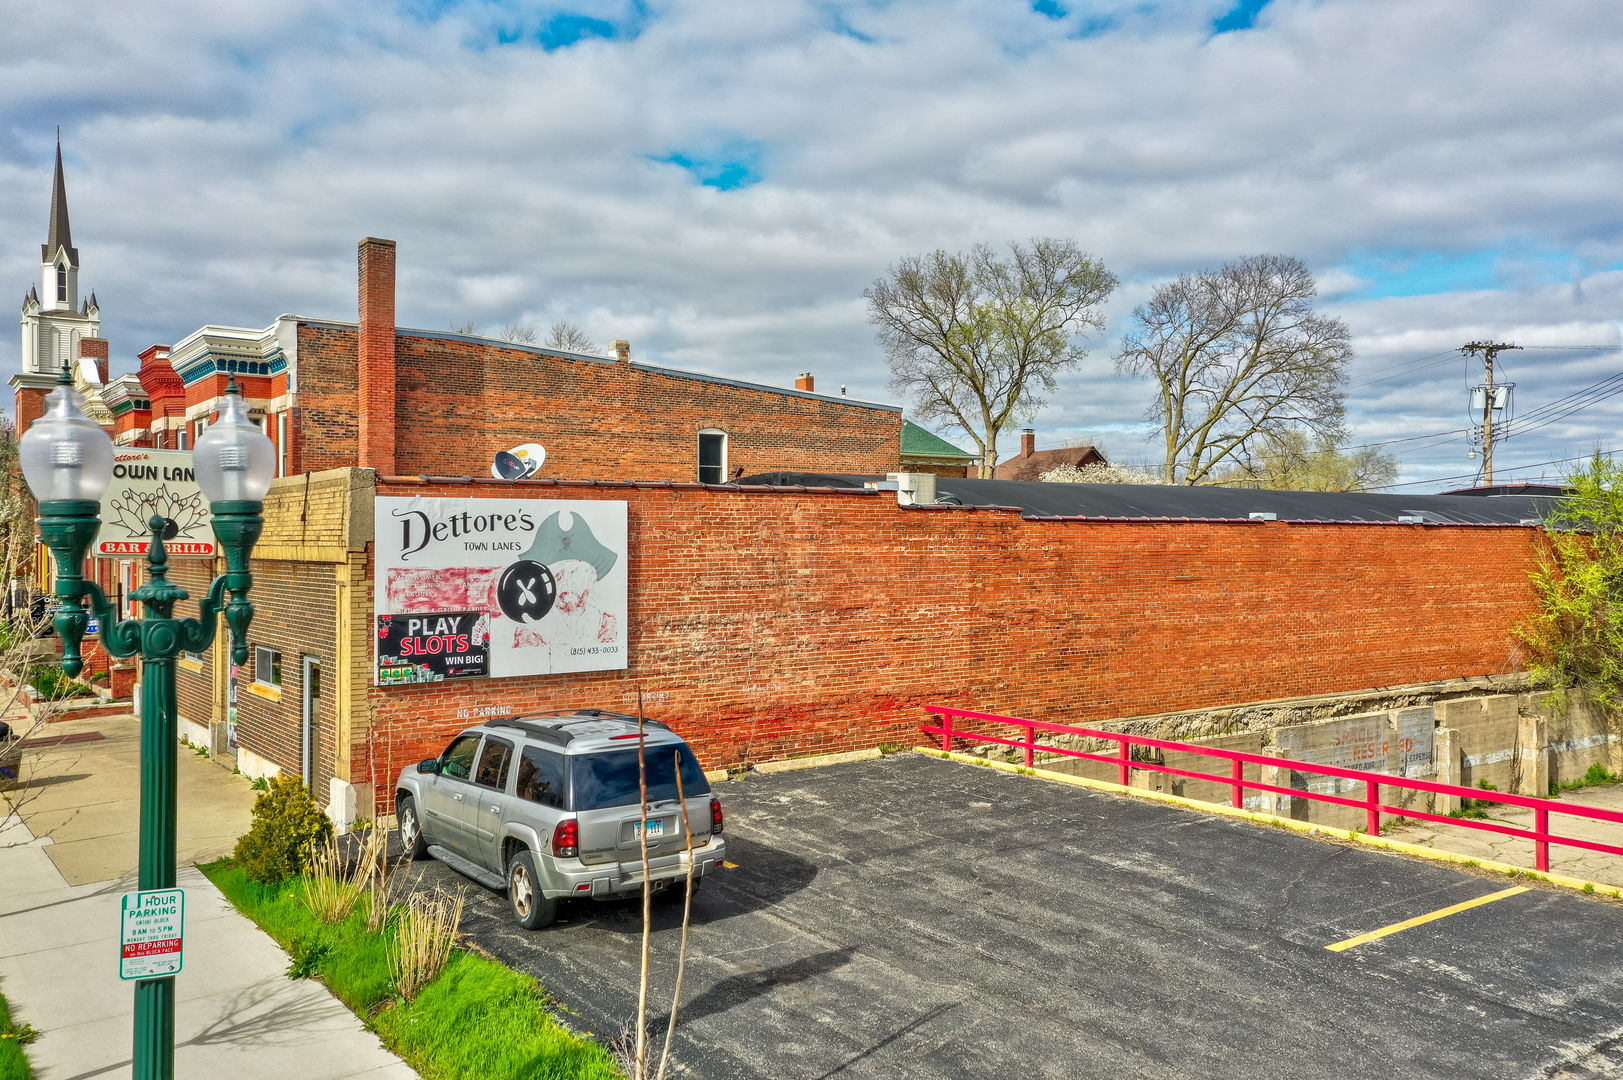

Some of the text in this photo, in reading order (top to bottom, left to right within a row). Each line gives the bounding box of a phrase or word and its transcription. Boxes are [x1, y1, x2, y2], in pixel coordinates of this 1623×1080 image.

[114, 452, 149, 462] ettore's
[113, 464, 195, 481] OWN LAN
[392, 509, 535, 560] Dettore's
[105, 543, 140, 553] BAR
[464, 541, 521, 551] TOWN LANES
[408, 617, 461, 636] PLAY
[400, 634, 469, 656] SLOTS
[570, 646, 619, 656] (815) 433-0033
[445, 655, 484, 665] WIN BIG!
[457, 705, 511, 718] NO PARKING
[1353, 738, 1414, 760] RESRED
[145, 896, 176, 906] HOUR
[129, 906, 177, 918] PARKING
[125, 939, 179, 952] NO REPARKING
